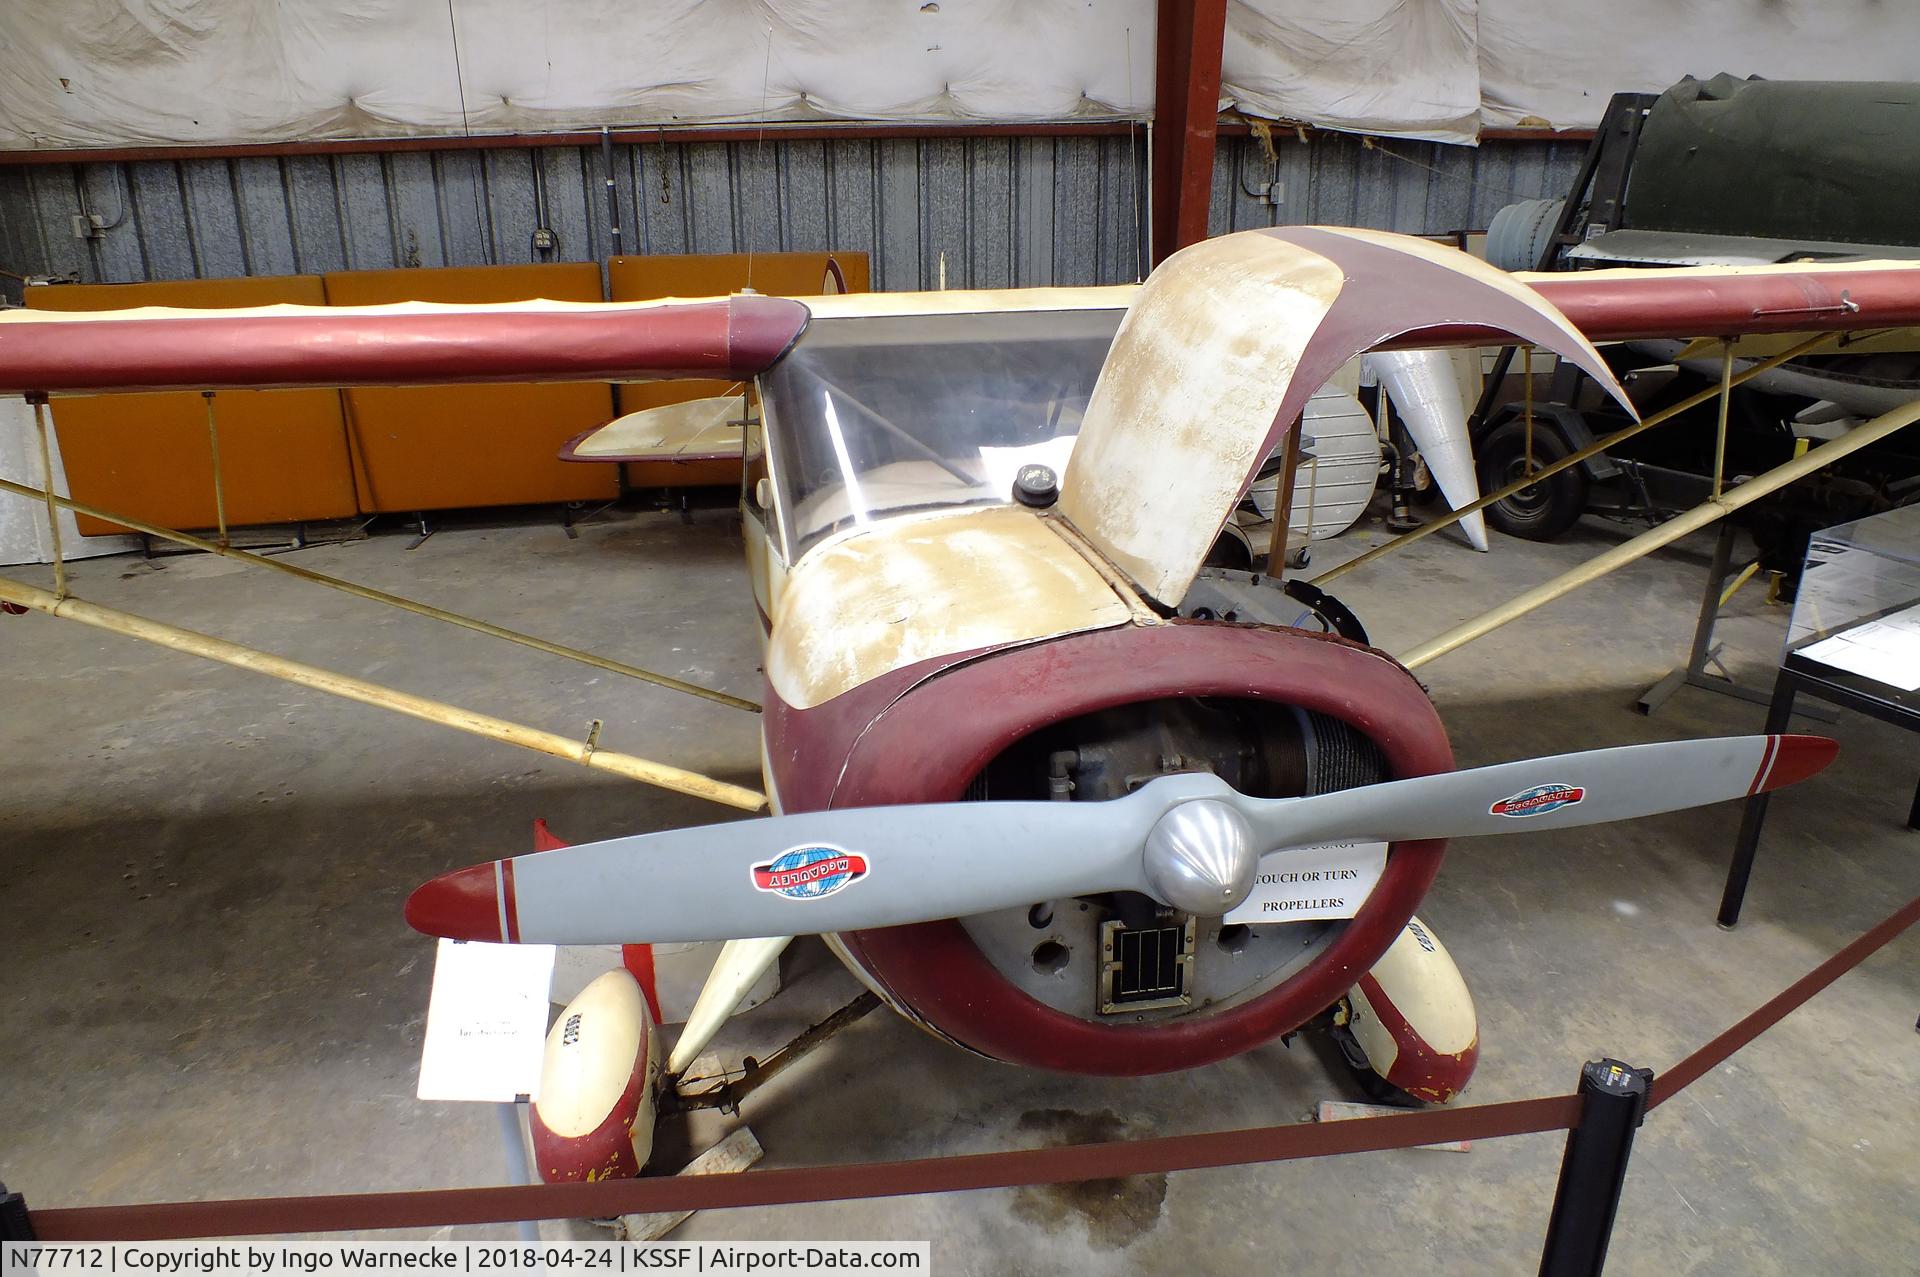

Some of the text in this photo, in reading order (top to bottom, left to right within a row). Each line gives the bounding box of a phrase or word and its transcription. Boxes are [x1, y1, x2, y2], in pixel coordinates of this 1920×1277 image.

[769, 860, 849, 887] McCAULEY
[1256, 869, 1359, 885] TOUCH OR TURN
[1263, 897, 1345, 912] PROPELLERS
